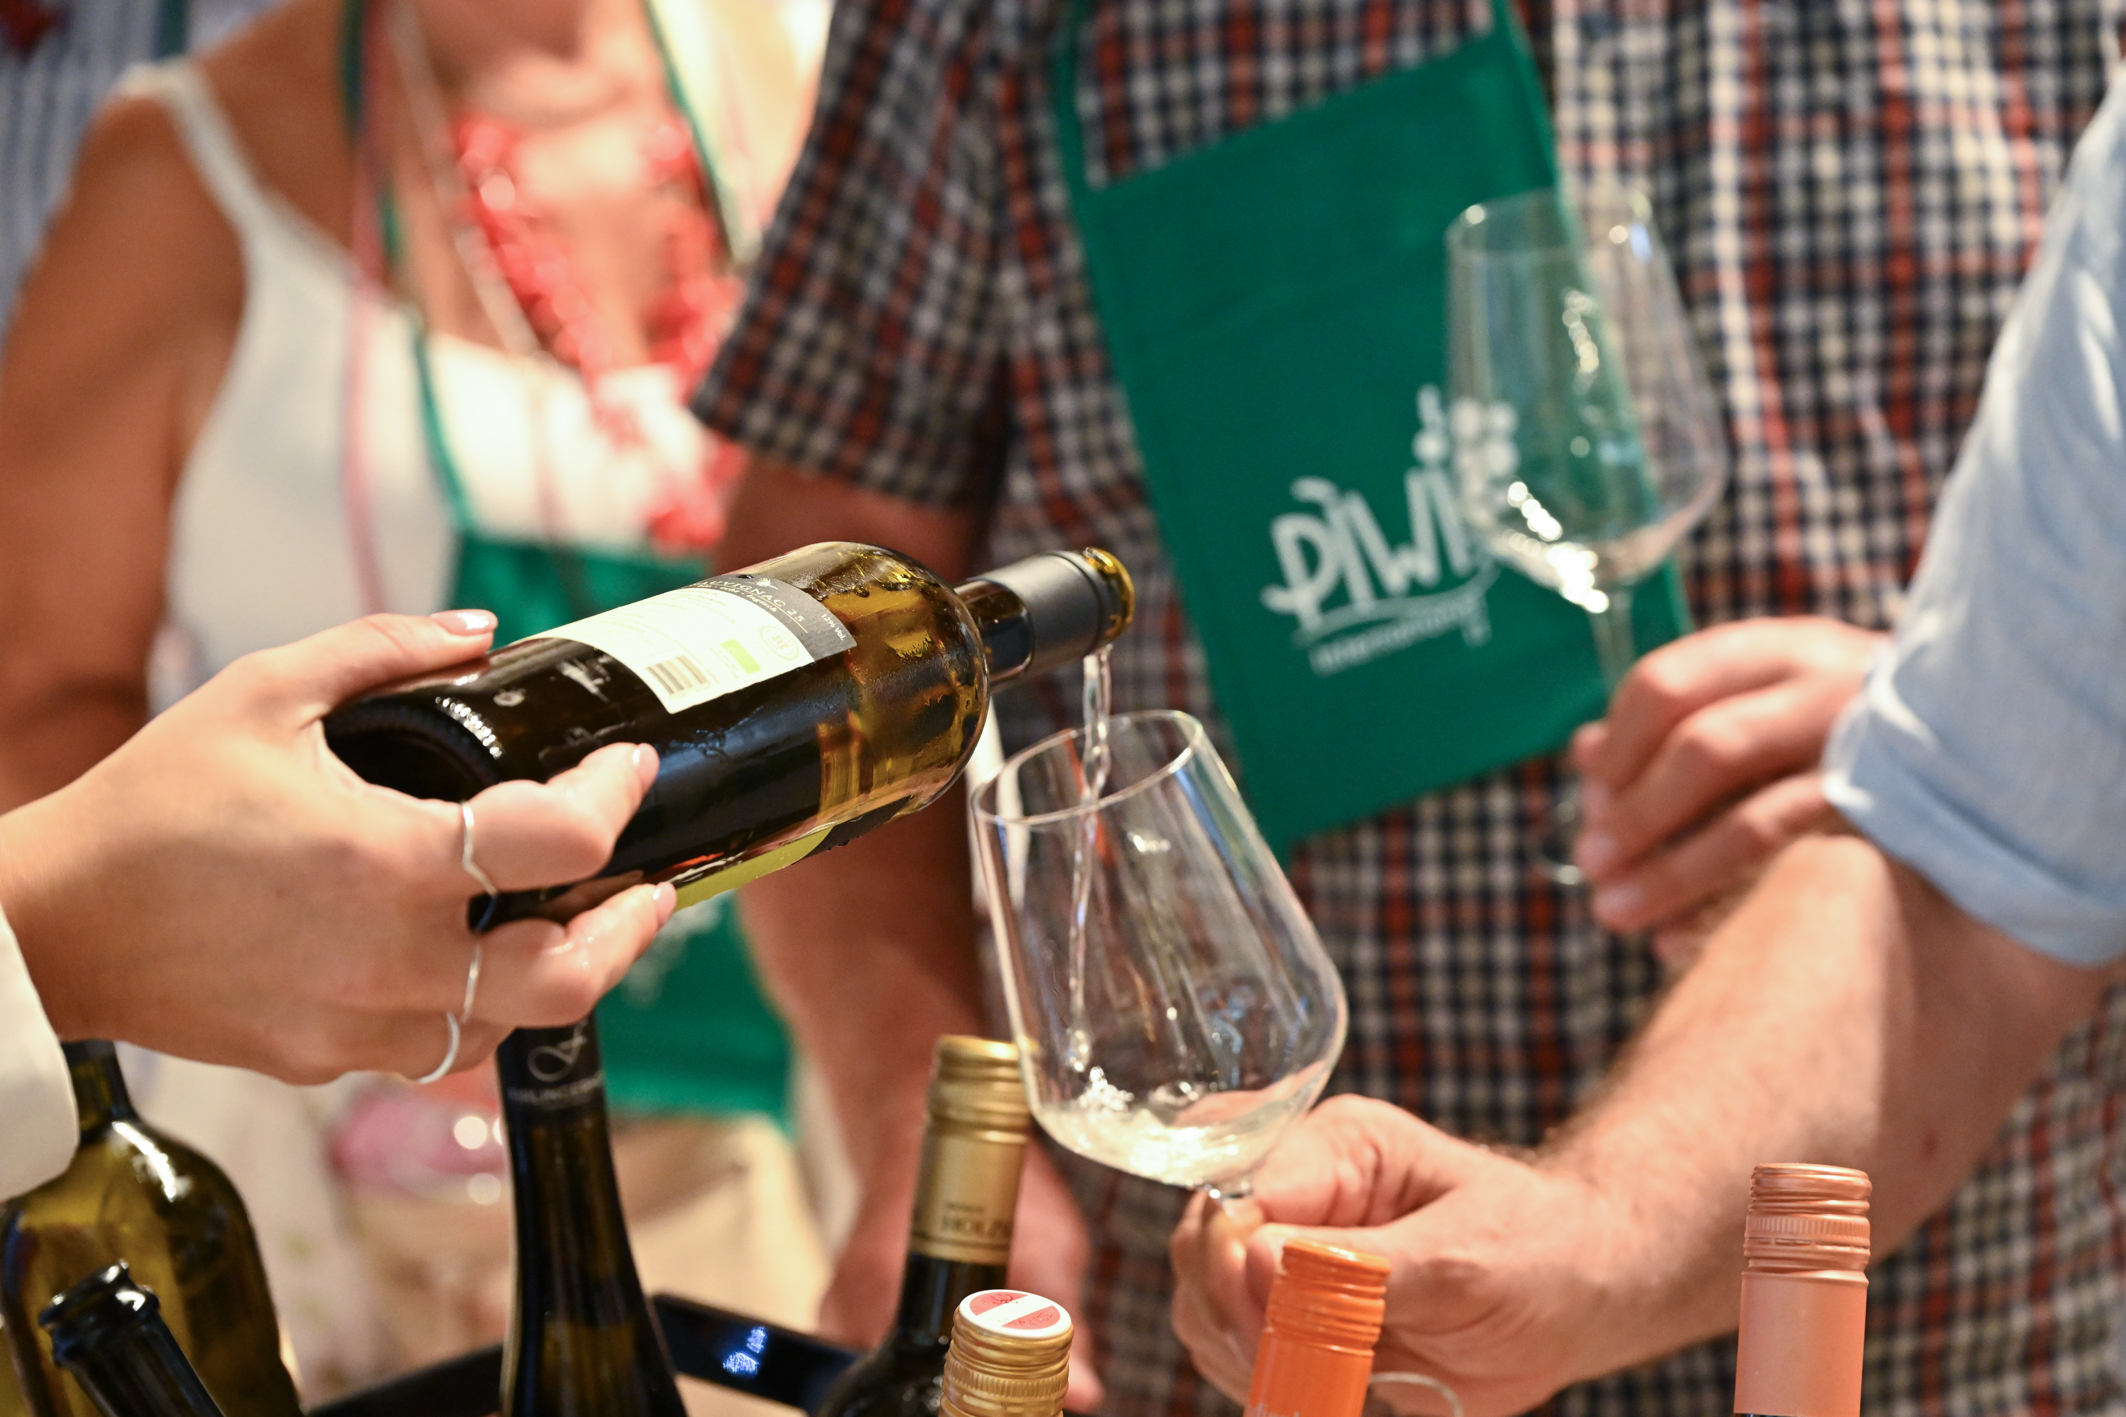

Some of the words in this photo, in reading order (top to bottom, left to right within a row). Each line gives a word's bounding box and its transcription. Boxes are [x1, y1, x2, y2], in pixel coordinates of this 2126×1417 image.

[746, 594, 777, 612] logisch
[787, 609, 806, 622] 25
[821, 613, 837, 628] 12%
[834, 627, 846, 641] Vol.
